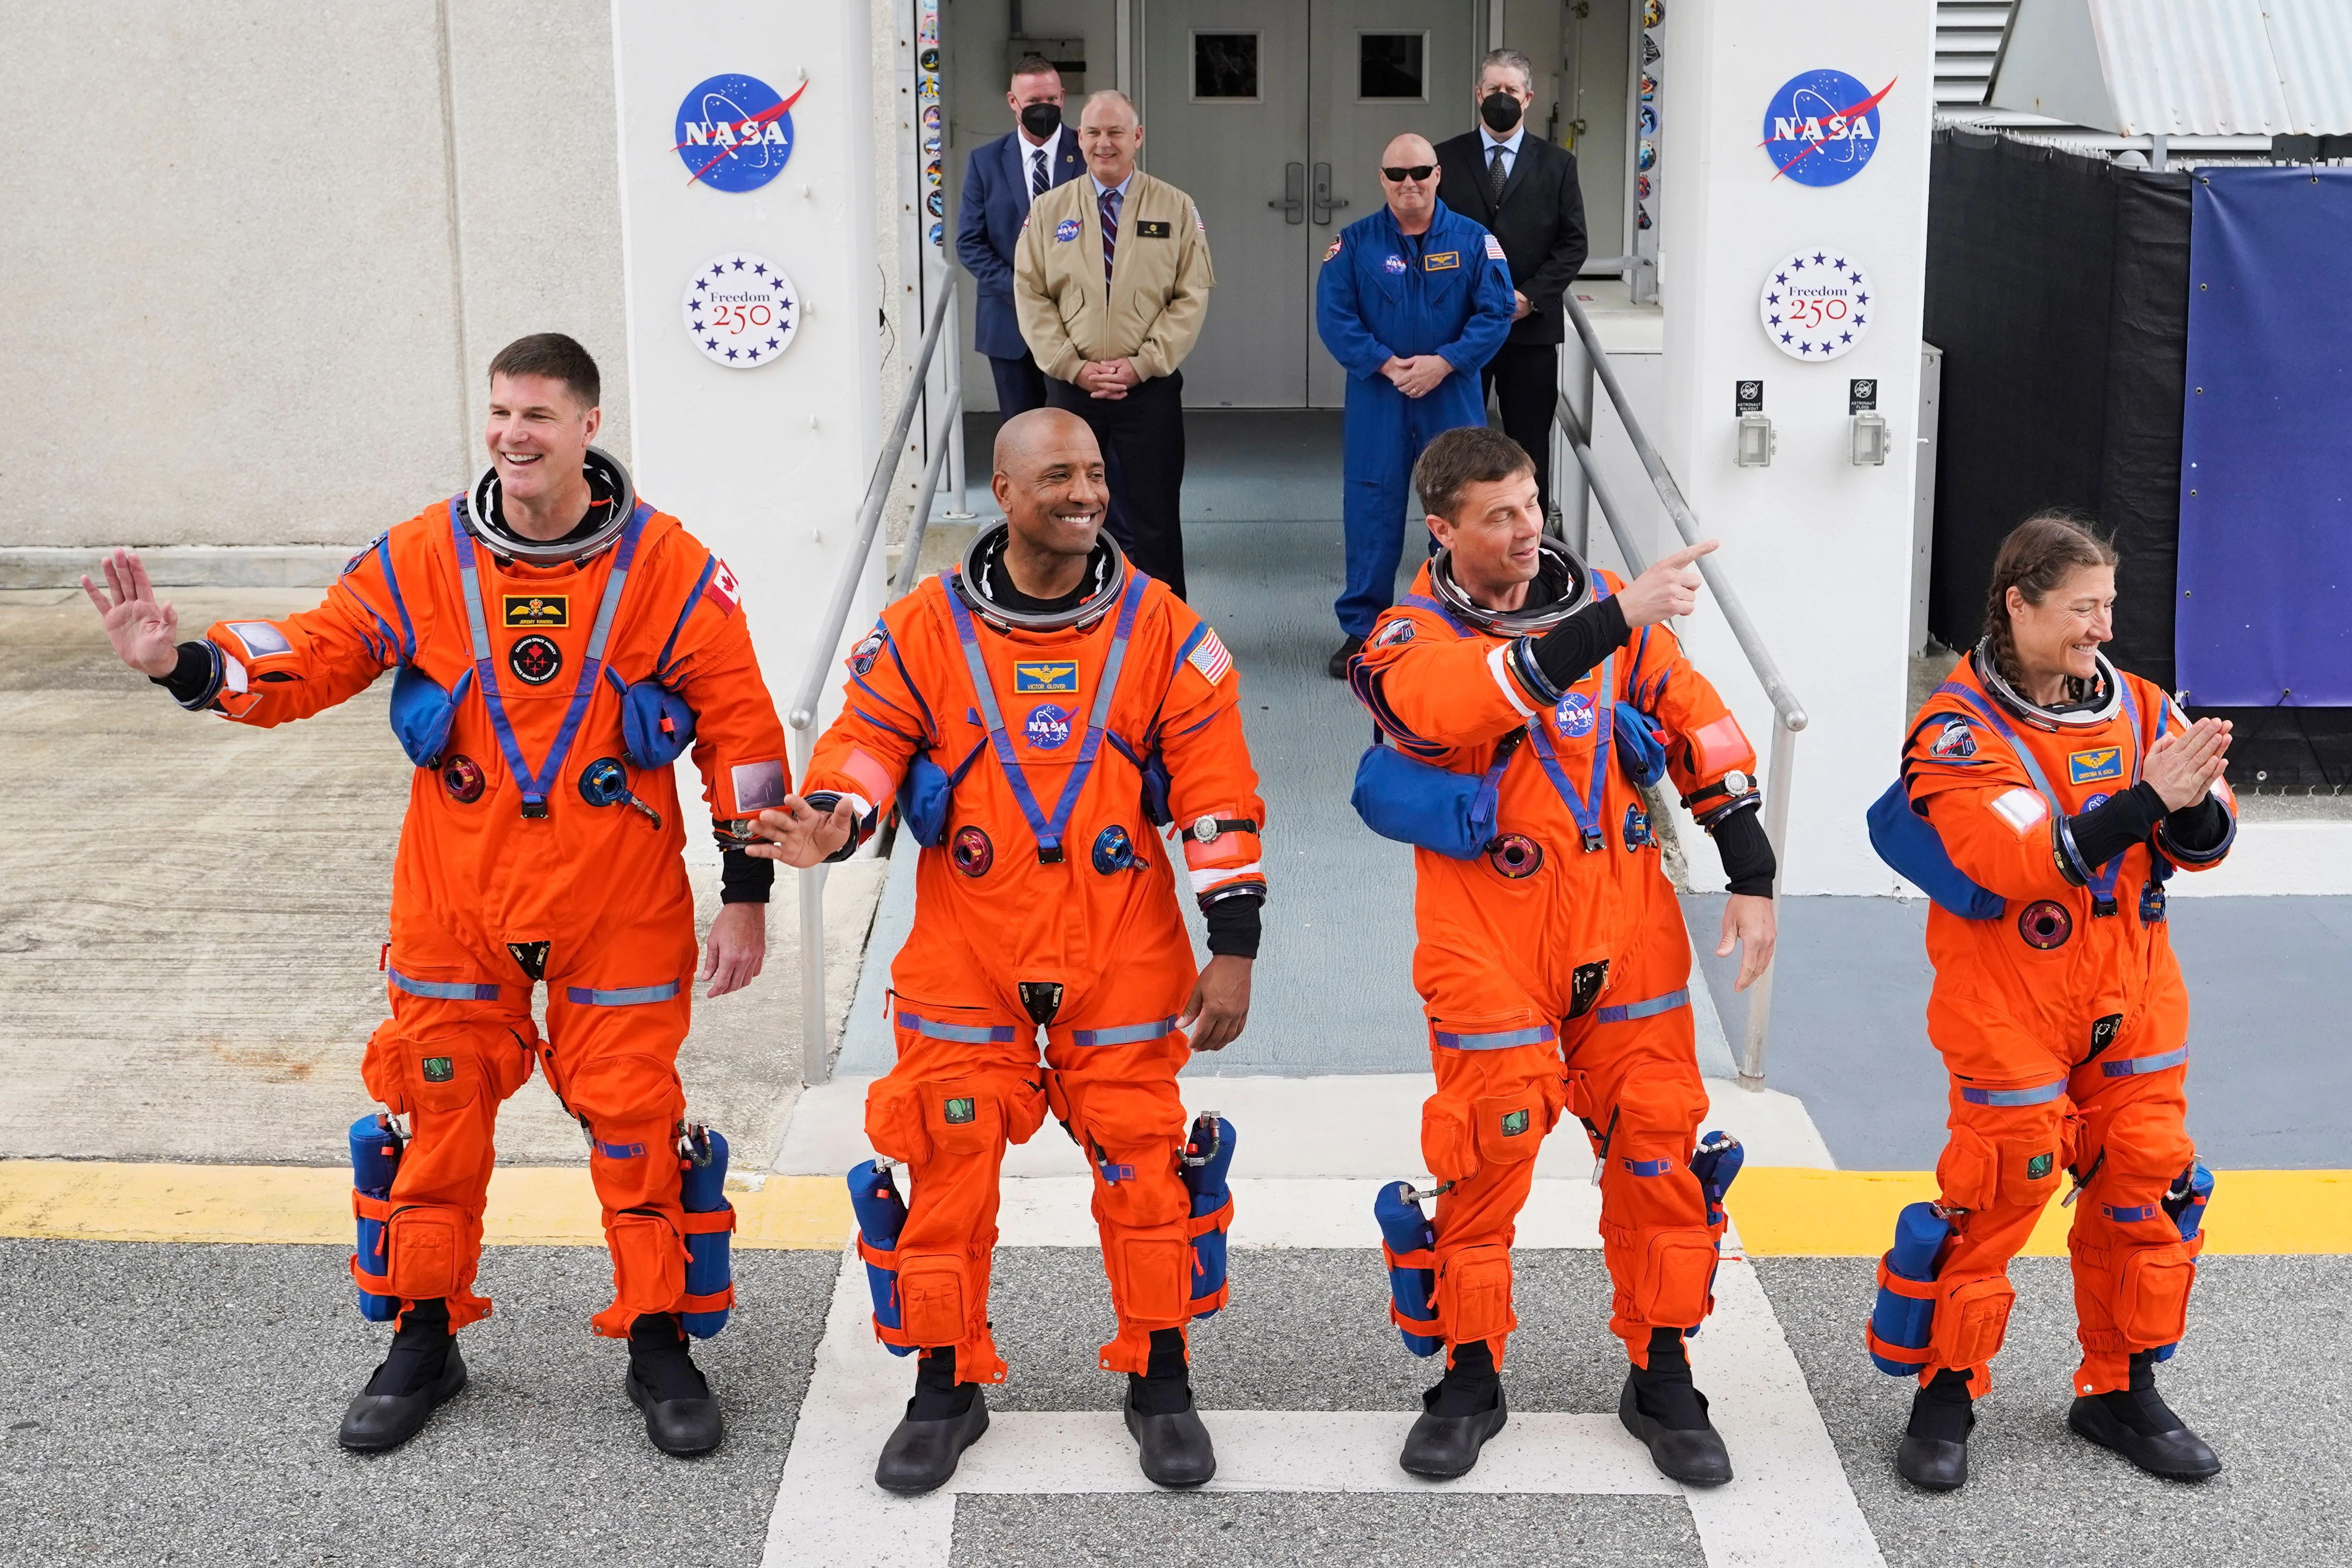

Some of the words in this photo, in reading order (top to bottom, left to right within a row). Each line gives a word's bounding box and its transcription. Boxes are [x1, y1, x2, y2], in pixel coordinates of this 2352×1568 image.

[684, 121, 788, 146] NASA
[1774, 116, 1874, 141] NASA
[1057, 226, 1078, 235] NASA
[1386, 260, 1407, 269] NASA
[710, 291, 770, 302] Freedom
[1789, 286, 1847, 296] Freedom
[1789, 298, 1847, 328] 250
[713, 305, 771, 335] 250
[1558, 708, 1593, 722] NASA
[1029, 721, 1069, 733] NASA
